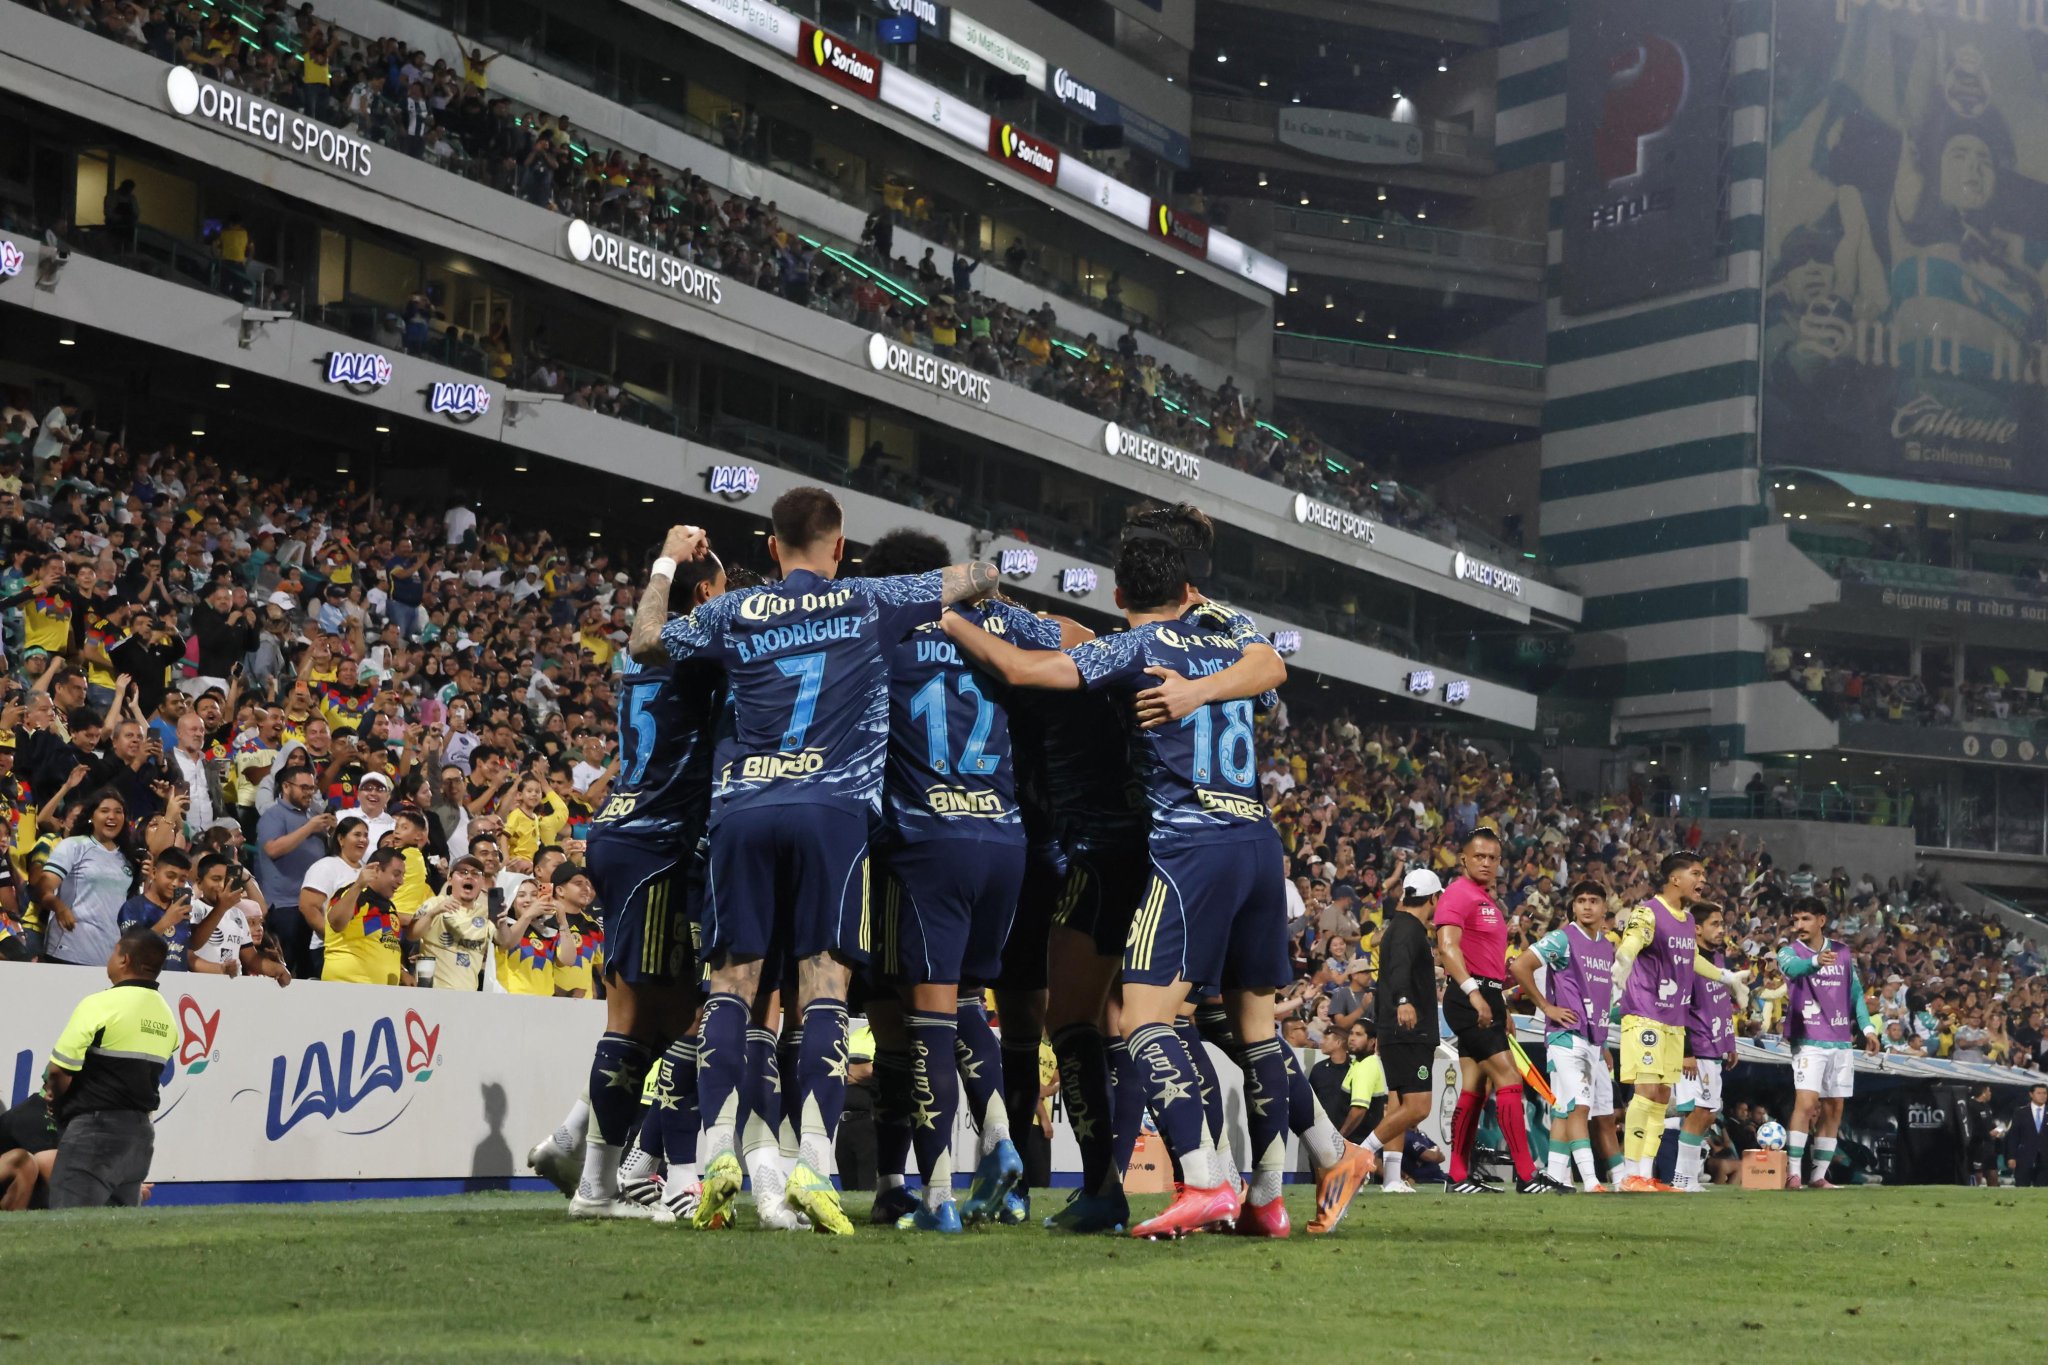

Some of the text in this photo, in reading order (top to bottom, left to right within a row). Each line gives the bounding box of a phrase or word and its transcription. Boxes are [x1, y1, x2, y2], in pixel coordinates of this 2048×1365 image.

[832, 46, 874, 84] Soriana
[1054, 68, 1096, 111] Corona
[200, 84, 372, 176] ORLEGI SPORTS
[1017, 140, 1053, 173] Soriana
[592, 233, 722, 304] ORLEGI SPORTS
[330, 353, 378, 384] LALA
[888, 345, 991, 403] ORLEGI SPORTS
[432, 383, 477, 413] LALA
[1891, 396, 2018, 444] Caliente
[1120, 432, 1200, 480] ORLEGI SPORTS
[712, 466, 749, 493] LALA
[1307, 502, 1375, 544] ORLEGI SPORTS
[1494, 569, 1521, 596] SPORTS
[735, 617, 864, 664] B.RODRÍGUEZ
[917, 641, 963, 666] VIOL
[1186, 656, 1235, 676] A.ME
[774, 651, 827, 752] 7
[911, 672, 1000, 775] 12
[1181, 700, 1255, 788] 18
[742, 752, 824, 779] BIMBO
[1817, 965, 1845, 976] ARLY
[266, 1016, 404, 1141] LALA
